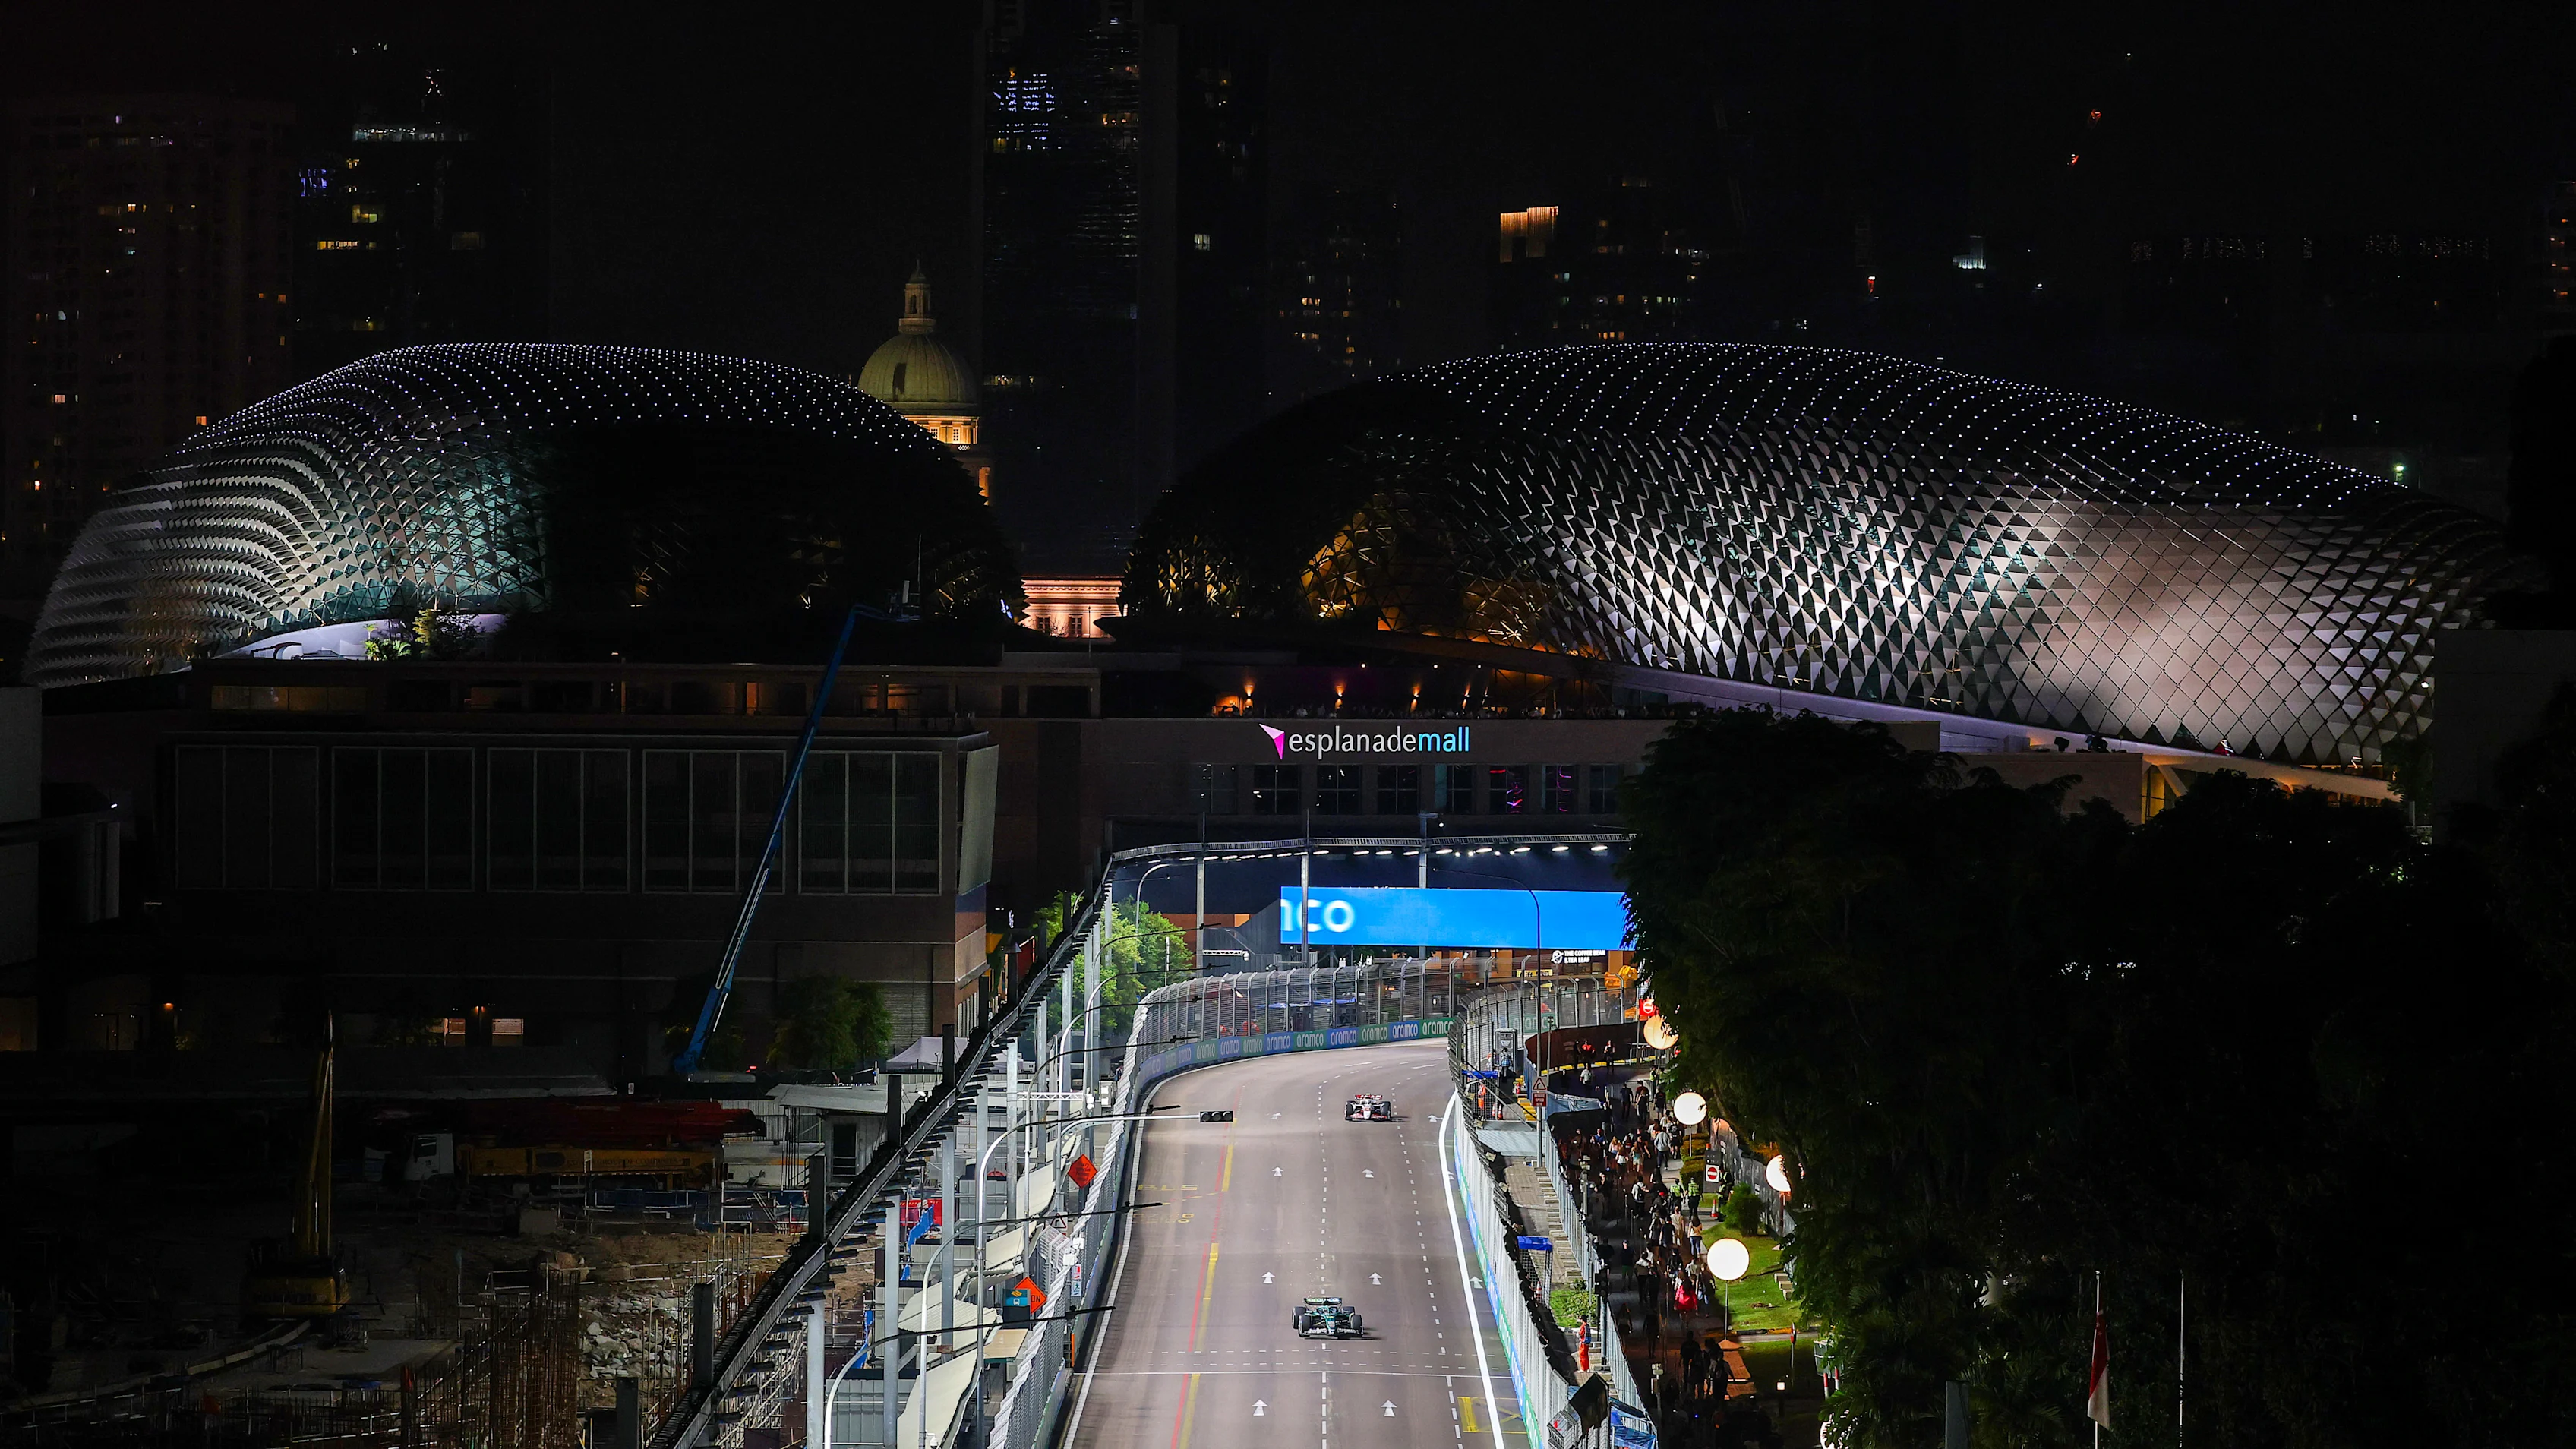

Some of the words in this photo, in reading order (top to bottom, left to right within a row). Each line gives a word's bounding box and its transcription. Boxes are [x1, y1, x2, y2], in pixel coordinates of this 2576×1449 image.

[1289, 725, 1469, 759] esplanademall
[1331, 1030, 1357, 1046] aramco
[1362, 1026, 1388, 1042] aramco
[1392, 1023, 1418, 1039] aramco
[1220, 1040, 1239, 1055] aramco
[1243, 1038, 1263, 1053] aramco
[1266, 1035, 1290, 1050] aramco
[1296, 1034, 1324, 1047] aramco
[1197, 1043, 1215, 1059] aramco
